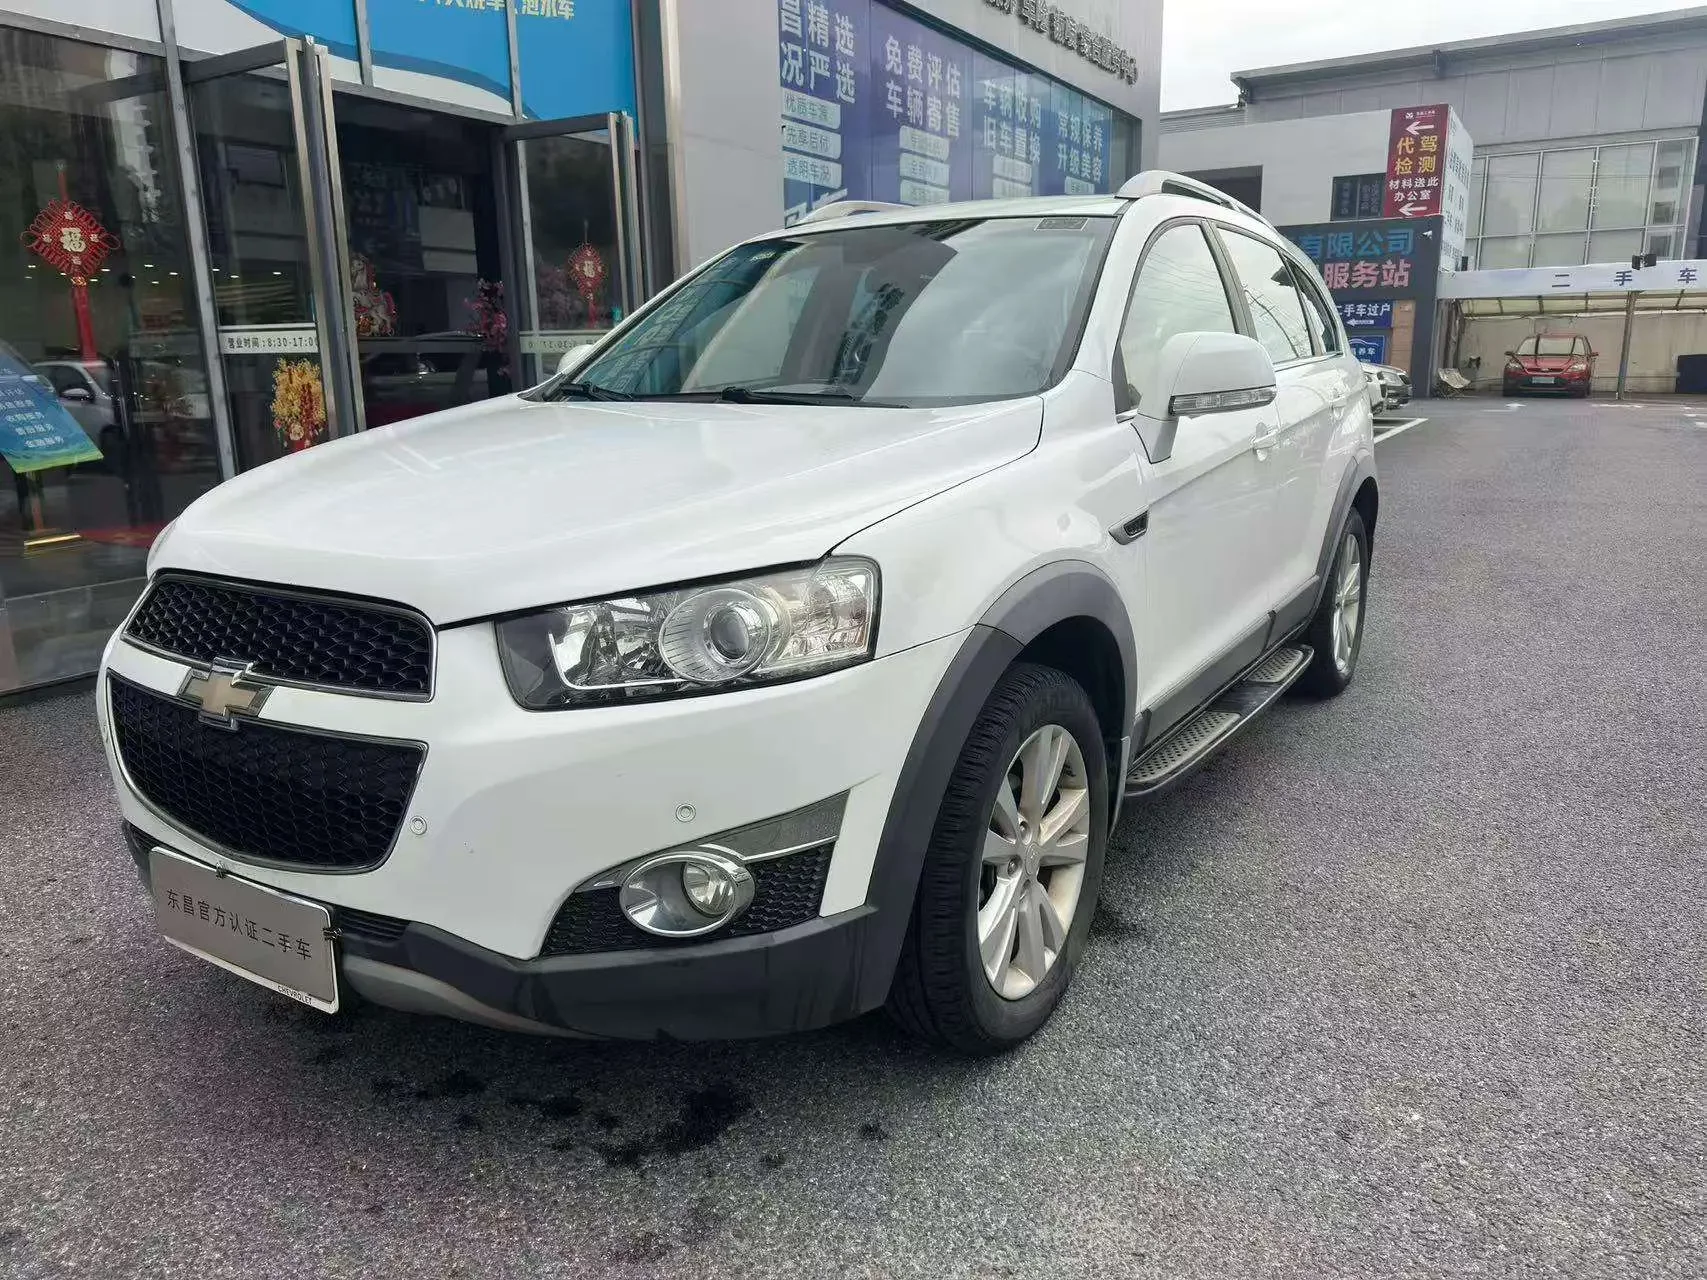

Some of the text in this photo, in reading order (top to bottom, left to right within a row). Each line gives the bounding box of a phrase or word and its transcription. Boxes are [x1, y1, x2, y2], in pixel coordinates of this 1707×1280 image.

[885, 35, 961, 99] 免费评估
[886, 80, 961, 138] 车辆寄售
[983, 115, 1041, 163] 旧车置换
[1396, 135, 1438, 155] 代驾
[1057, 142, 1102, 183] 升级美容
[1394, 155, 1436, 176] 检测
[1388, 177, 1439, 190] 材料送此
[1393, 190, 1432, 202] 办公室
[60, 227, 87, 253] 福
[1299, 228, 1415, 259] 有限公司
[1323, 258, 1412, 289] 服务站
[1551, 267, 1698, 288] 二手车
[166, 888, 313, 960] 东昌官方认证二手车
[277, 985, 313, 1004] CHEVROLET
